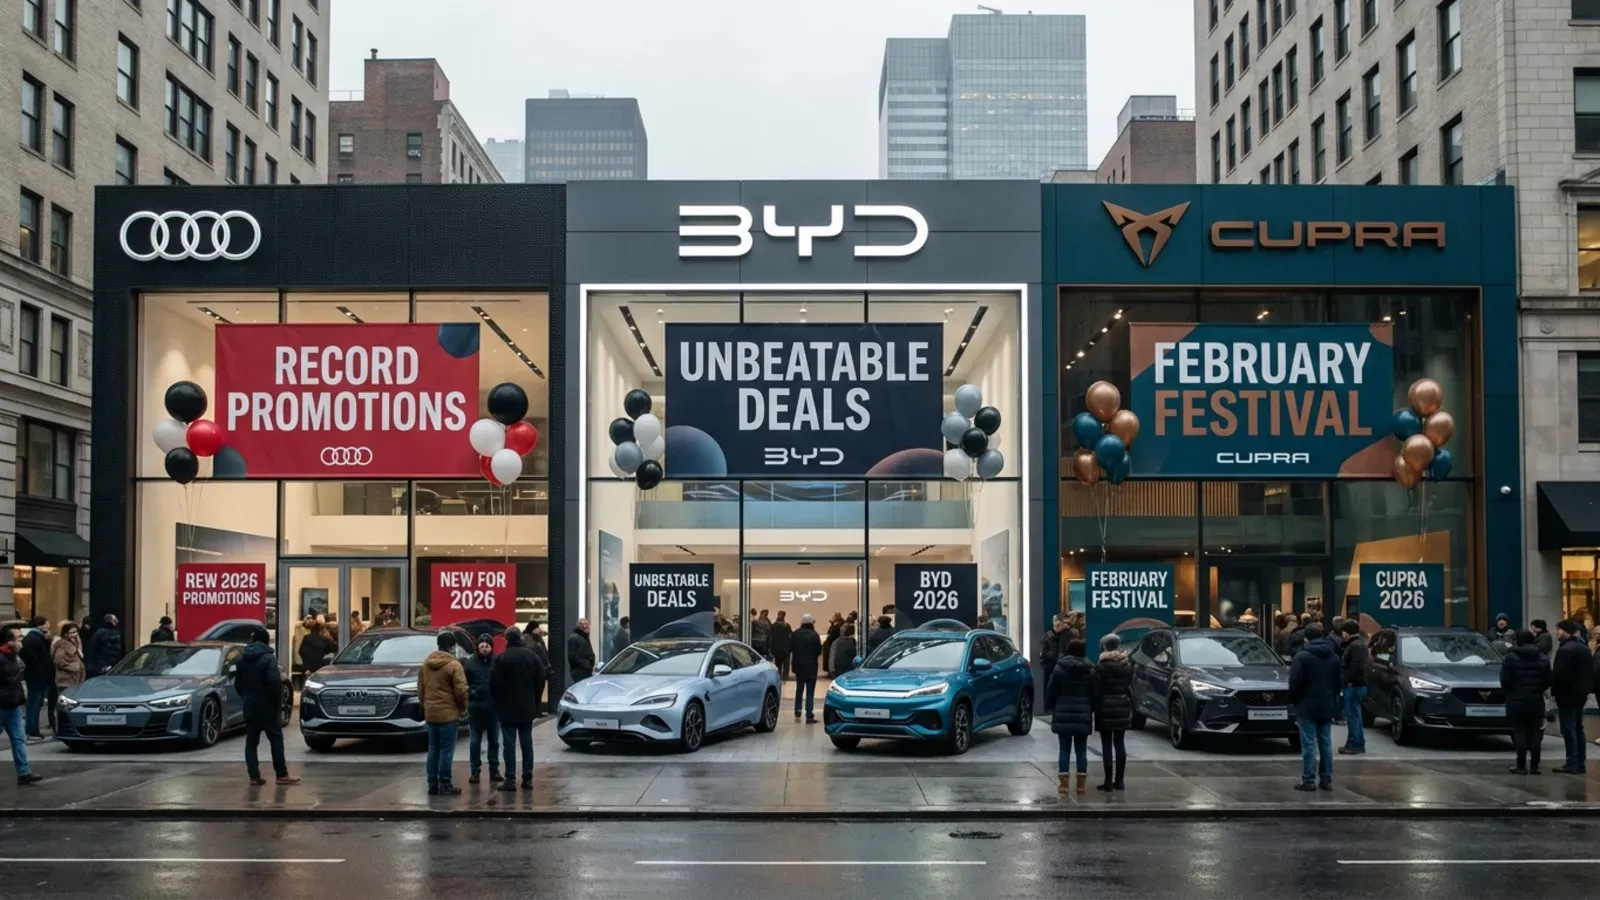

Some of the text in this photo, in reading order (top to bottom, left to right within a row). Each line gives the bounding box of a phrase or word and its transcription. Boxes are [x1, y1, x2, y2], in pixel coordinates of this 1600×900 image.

[678, 205, 929, 259] BYD
[1210, 220, 1446, 248] CUPRA
[275, 345, 419, 386] RECORD
[680, 341, 929, 382] UNBEATABLE
[1154, 341, 1372, 385] FEBRUARY
[227, 391, 467, 432] PROMOTIONS
[738, 388, 871, 431] DEALS
[1154, 389, 1373, 437] FESTIVAL
[764, 447, 845, 466] BYD
[1216, 452, 1310, 464] CUPRA
[185, 572, 258, 589] REW 2026
[440, 571, 506, 588] NEW FOR
[634, 573, 709, 587] UNBEATABLE
[919, 570, 952, 588] BYD
[1091, 571, 1168, 588] FEBRUARY
[1375, 570, 1428, 588] CUPRA
[183, 591, 260, 605] PROMOTIONS
[450, 589, 496, 610] 2026
[647, 590, 697, 608] DEALS
[779, 590, 828, 602] BYD
[913, 590, 959, 610] 2026
[1091, 590, 1168, 609] FESTIVAL
[1379, 590, 1425, 610] 2026
